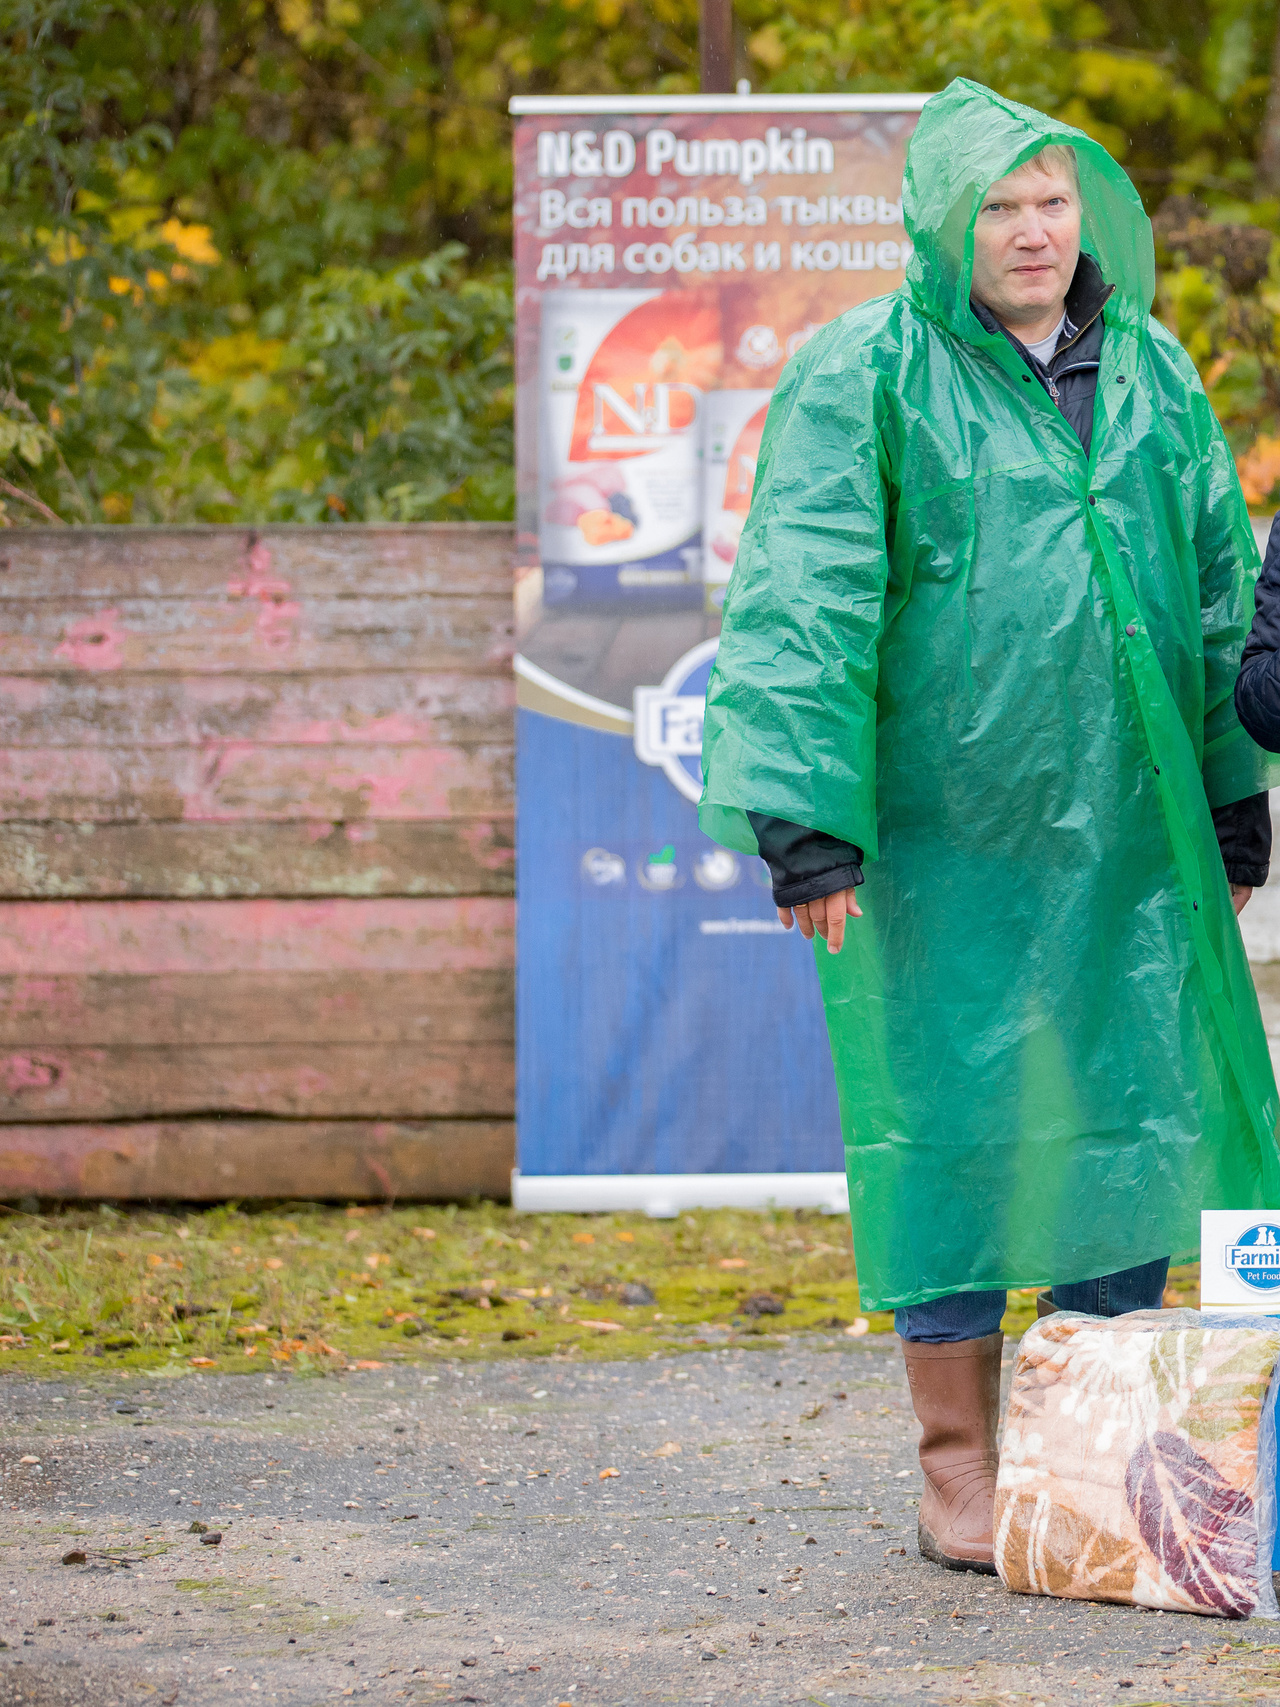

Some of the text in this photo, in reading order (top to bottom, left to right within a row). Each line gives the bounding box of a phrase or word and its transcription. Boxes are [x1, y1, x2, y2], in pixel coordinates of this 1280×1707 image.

[537, 126, 834, 185] N&D Pumpkin
[539, 189, 904, 229] Вся польза тыквы
[536, 241, 615, 281] для
[623, 233, 745, 273] собак
[753, 241, 782, 271] и
[1247, 1272, 1260, 1281] Pet
